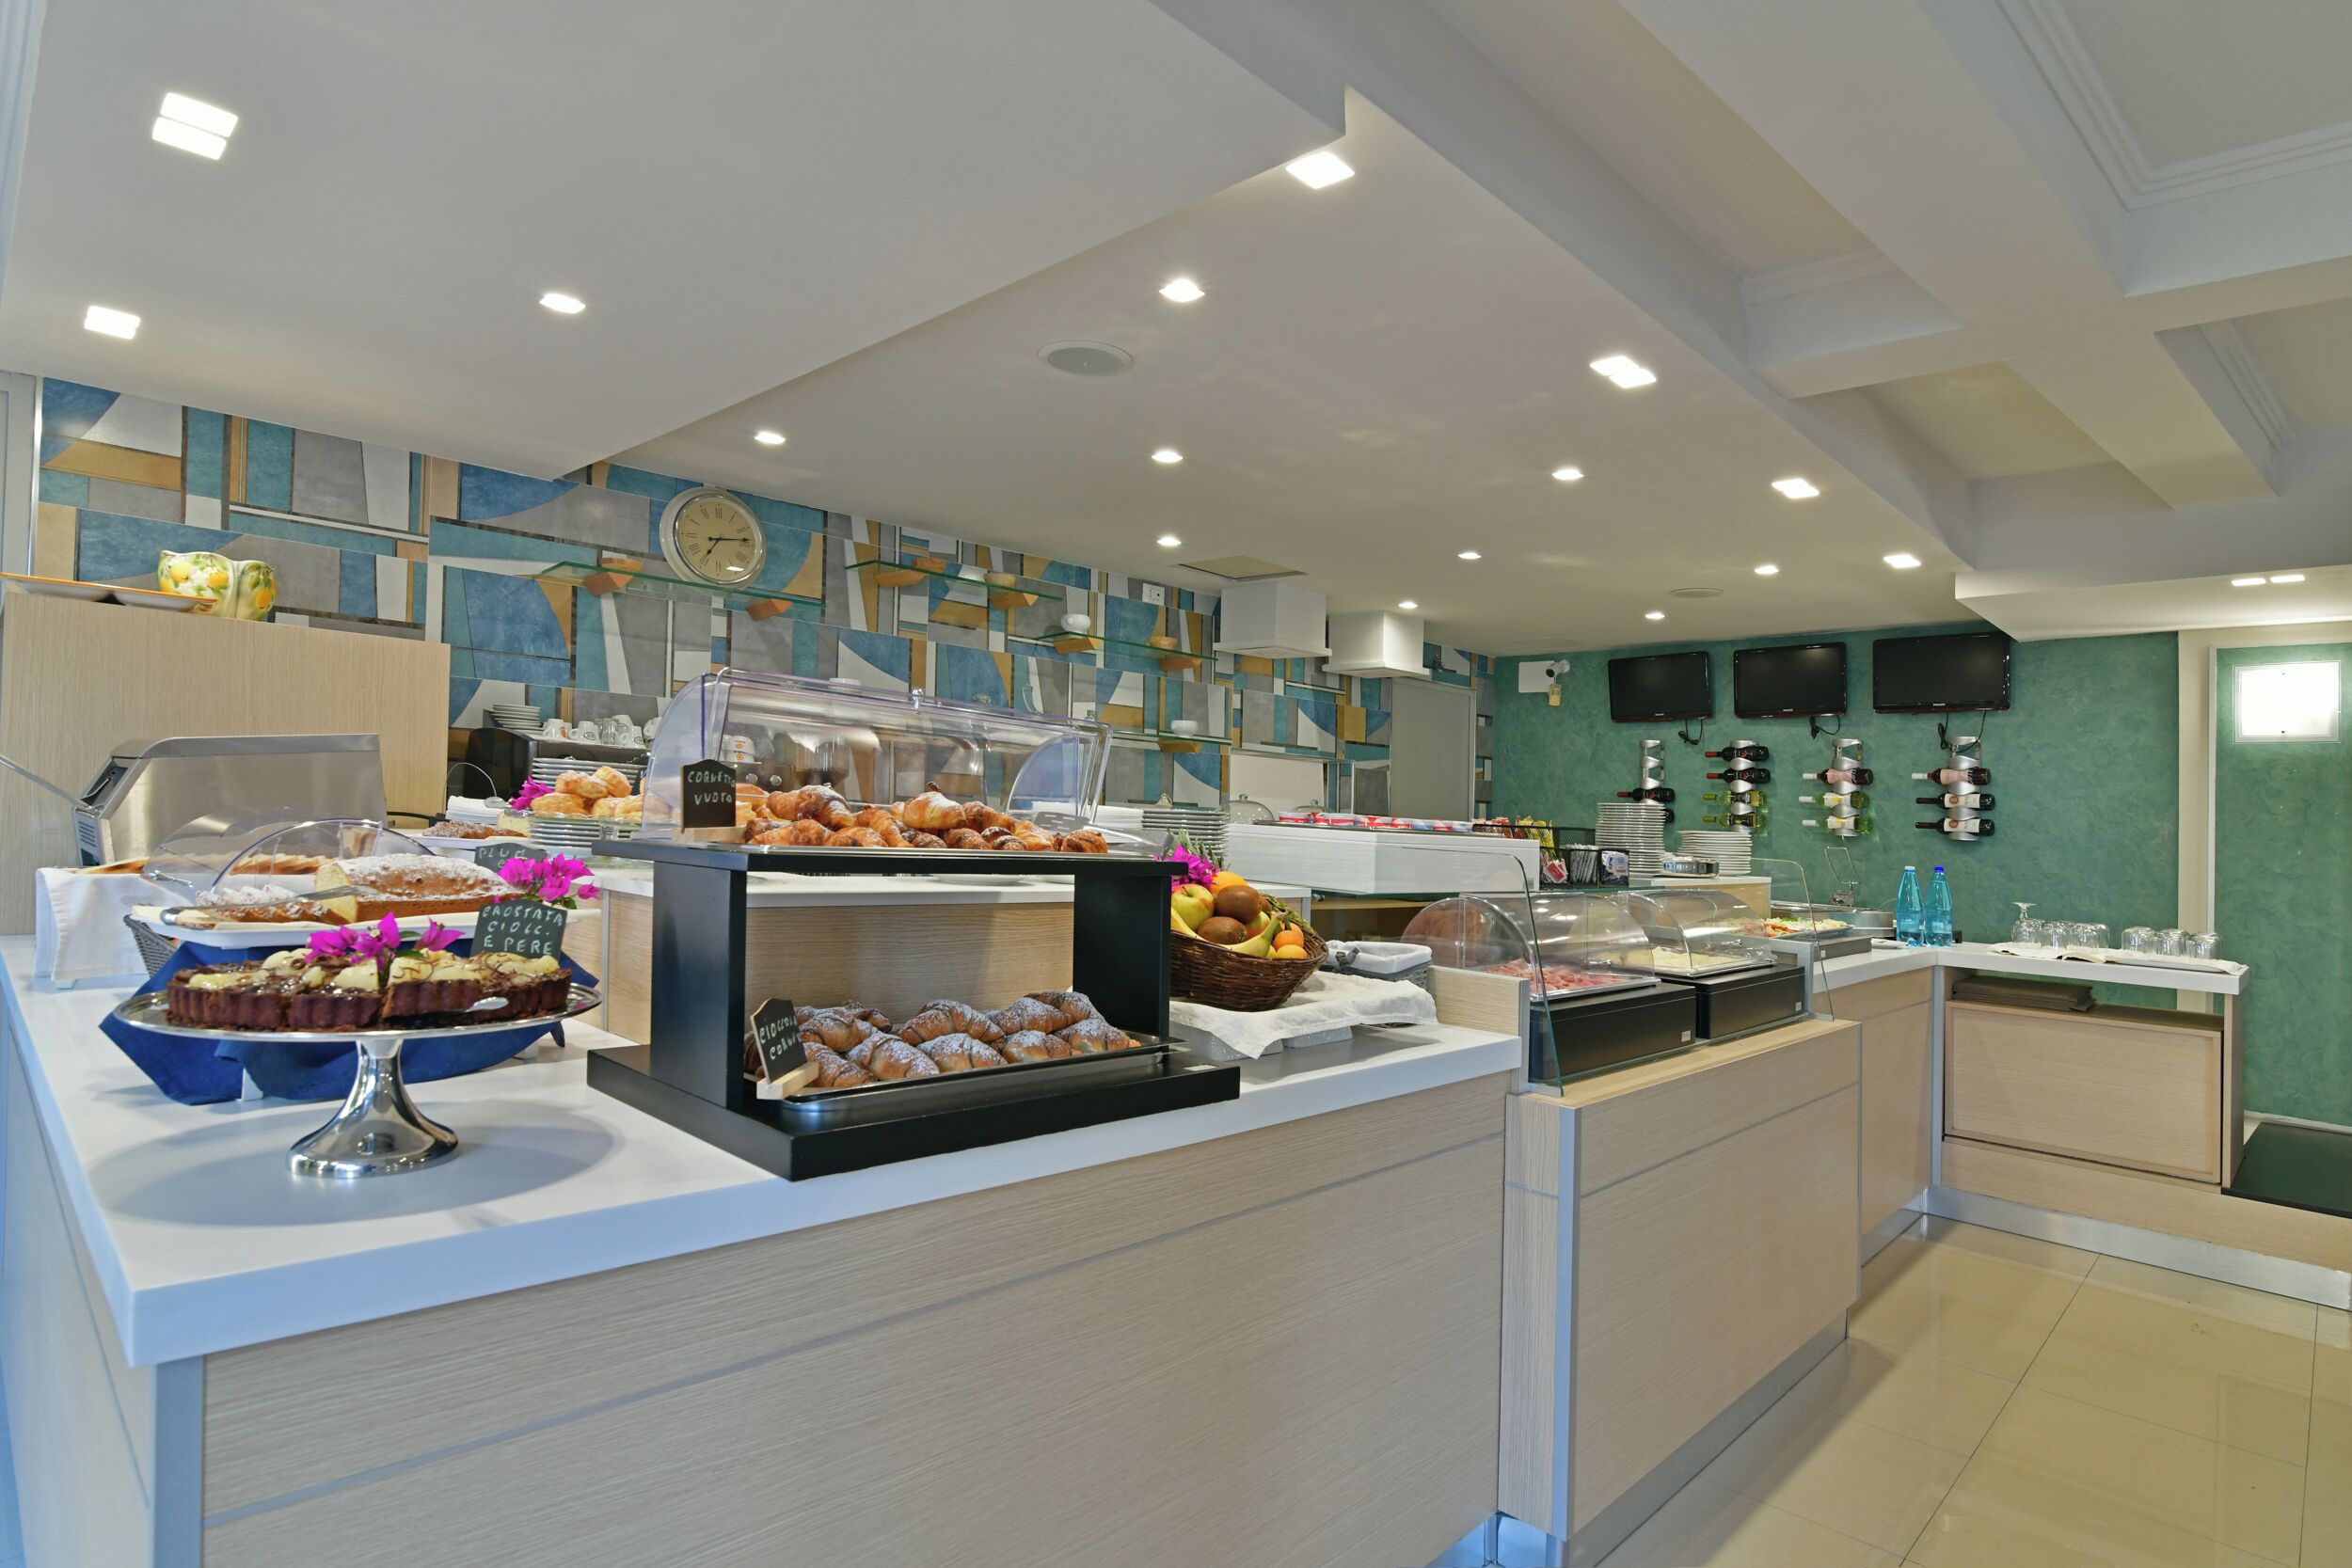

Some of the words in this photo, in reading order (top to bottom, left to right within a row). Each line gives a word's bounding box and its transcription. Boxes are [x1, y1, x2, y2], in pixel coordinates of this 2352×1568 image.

[482, 905, 564, 927] CROSTATA
[483, 934, 494, 948] E
[503, 937, 554, 955] PERE
